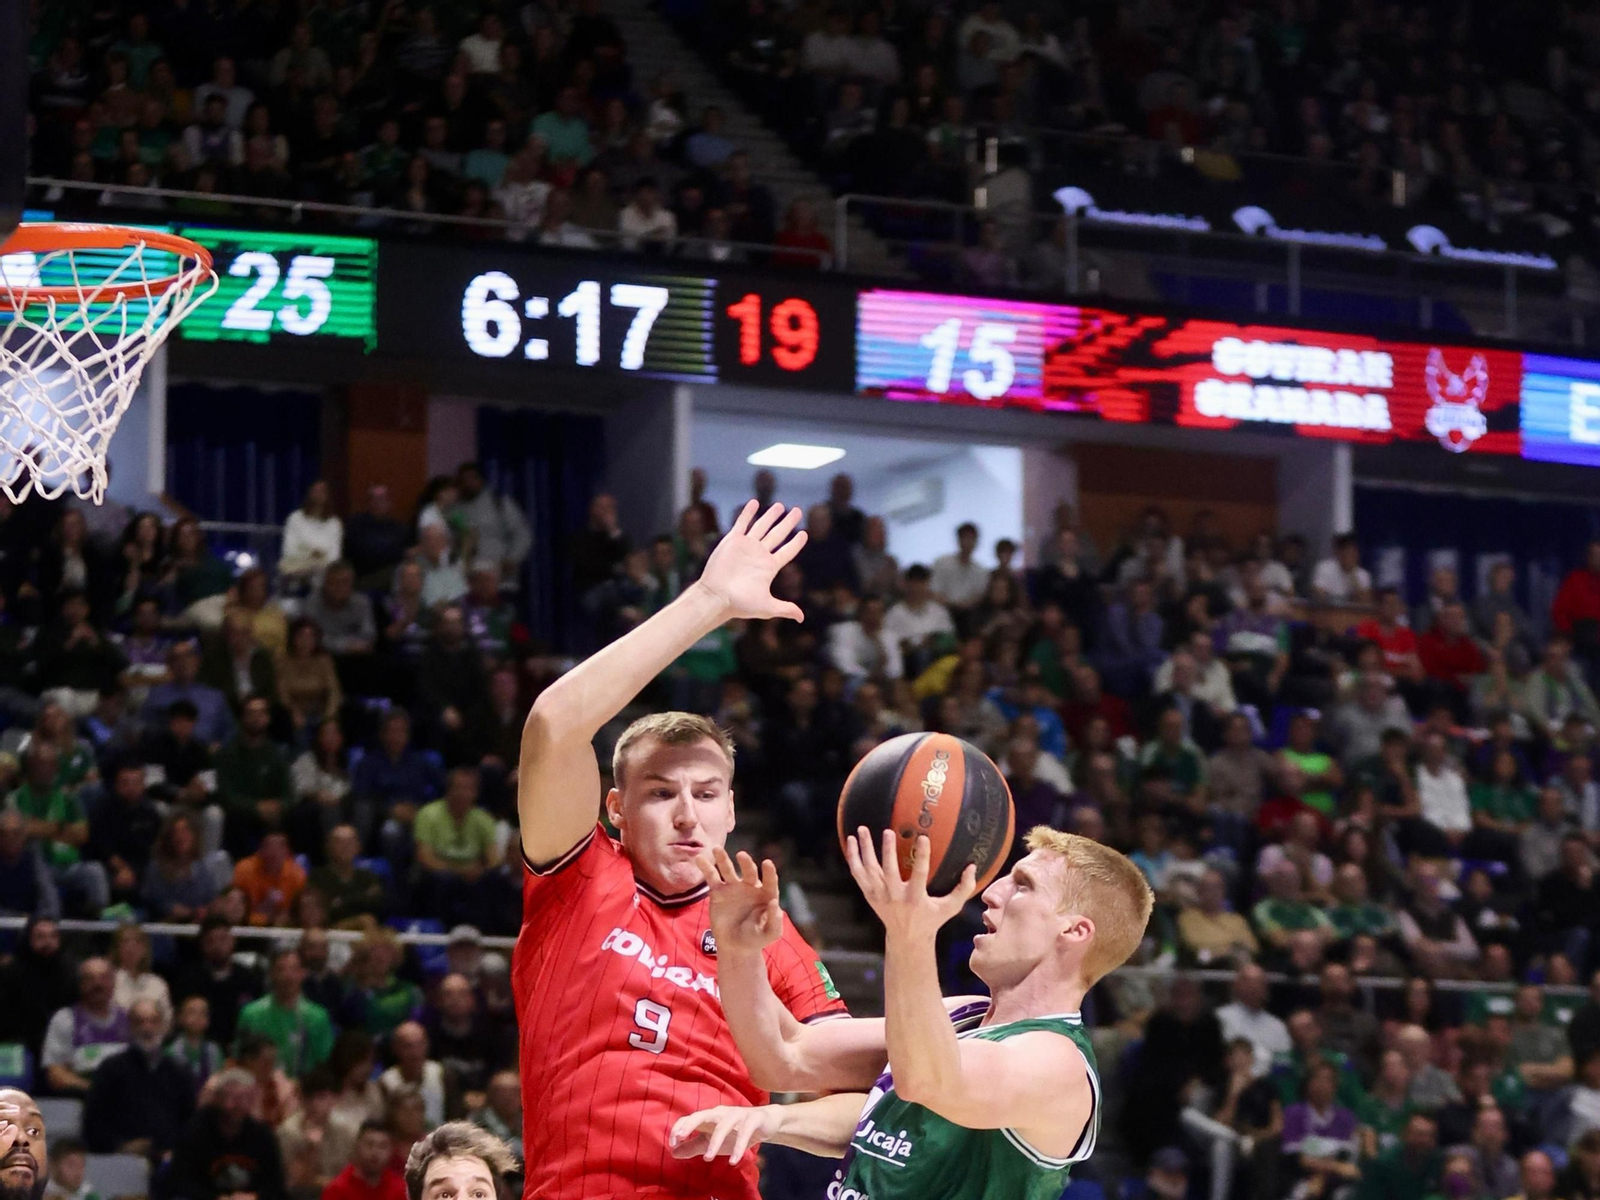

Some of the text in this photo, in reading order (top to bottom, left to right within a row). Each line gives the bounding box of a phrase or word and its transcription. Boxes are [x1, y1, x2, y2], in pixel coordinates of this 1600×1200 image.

[221, 251, 336, 335] 25
[461, 271, 669, 371] 6:17
[726, 293, 820, 371] 19
[920, 317, 1017, 400] 15
[628, 997, 673, 1055] 9
